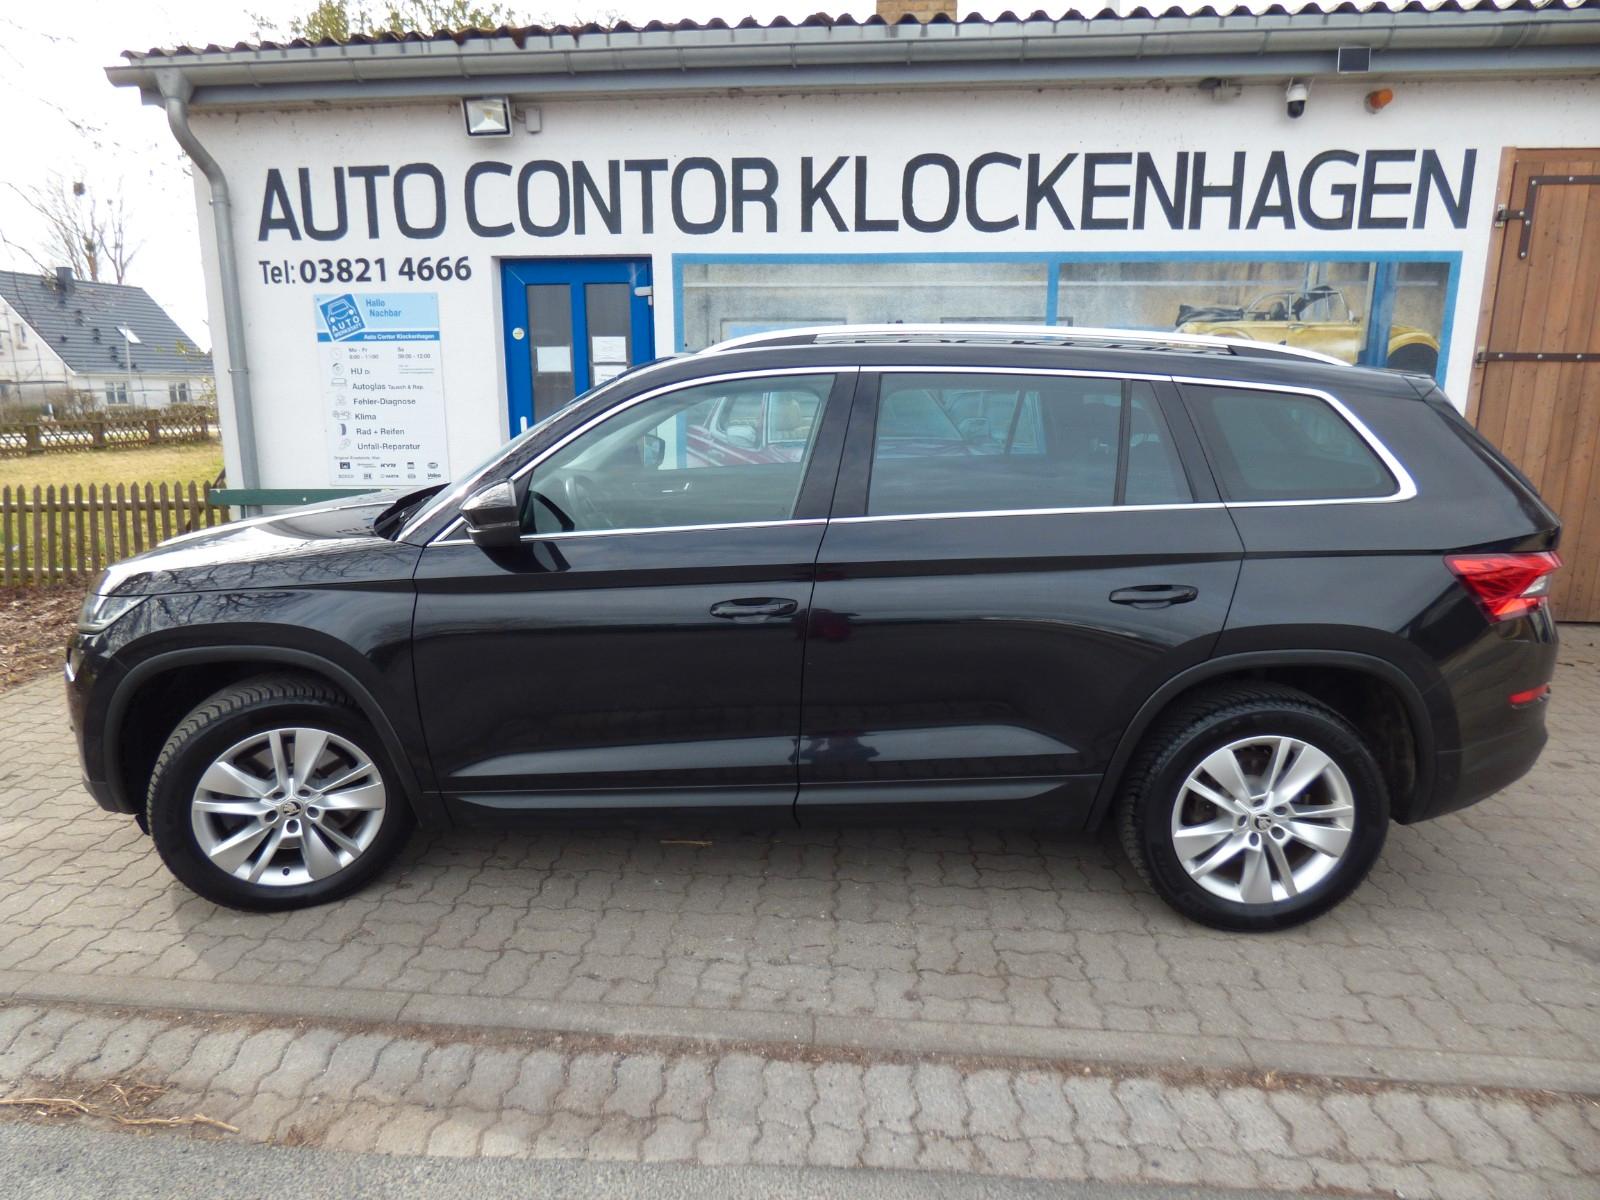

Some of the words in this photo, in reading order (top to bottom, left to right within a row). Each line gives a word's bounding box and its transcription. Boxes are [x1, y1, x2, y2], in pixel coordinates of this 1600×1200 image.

[258, 162, 447, 241] AUTO
[464, 156, 779, 238] CONTOR
[801, 148, 1478, 232] KLOCKENHAGEN
[259, 259, 296, 285] Tel:
[299, 257, 388, 284] 03821
[398, 255, 472, 282] 4666
[365, 298, 386, 307] Hallo
[369, 309, 402, 317] Nachbar
[331, 315, 360, 333] AUTO
[352, 383, 386, 391] Autoglas
[353, 398, 416, 406] Fehler-Diagnose
[357, 443, 420, 451] Unfall-Reparatur
